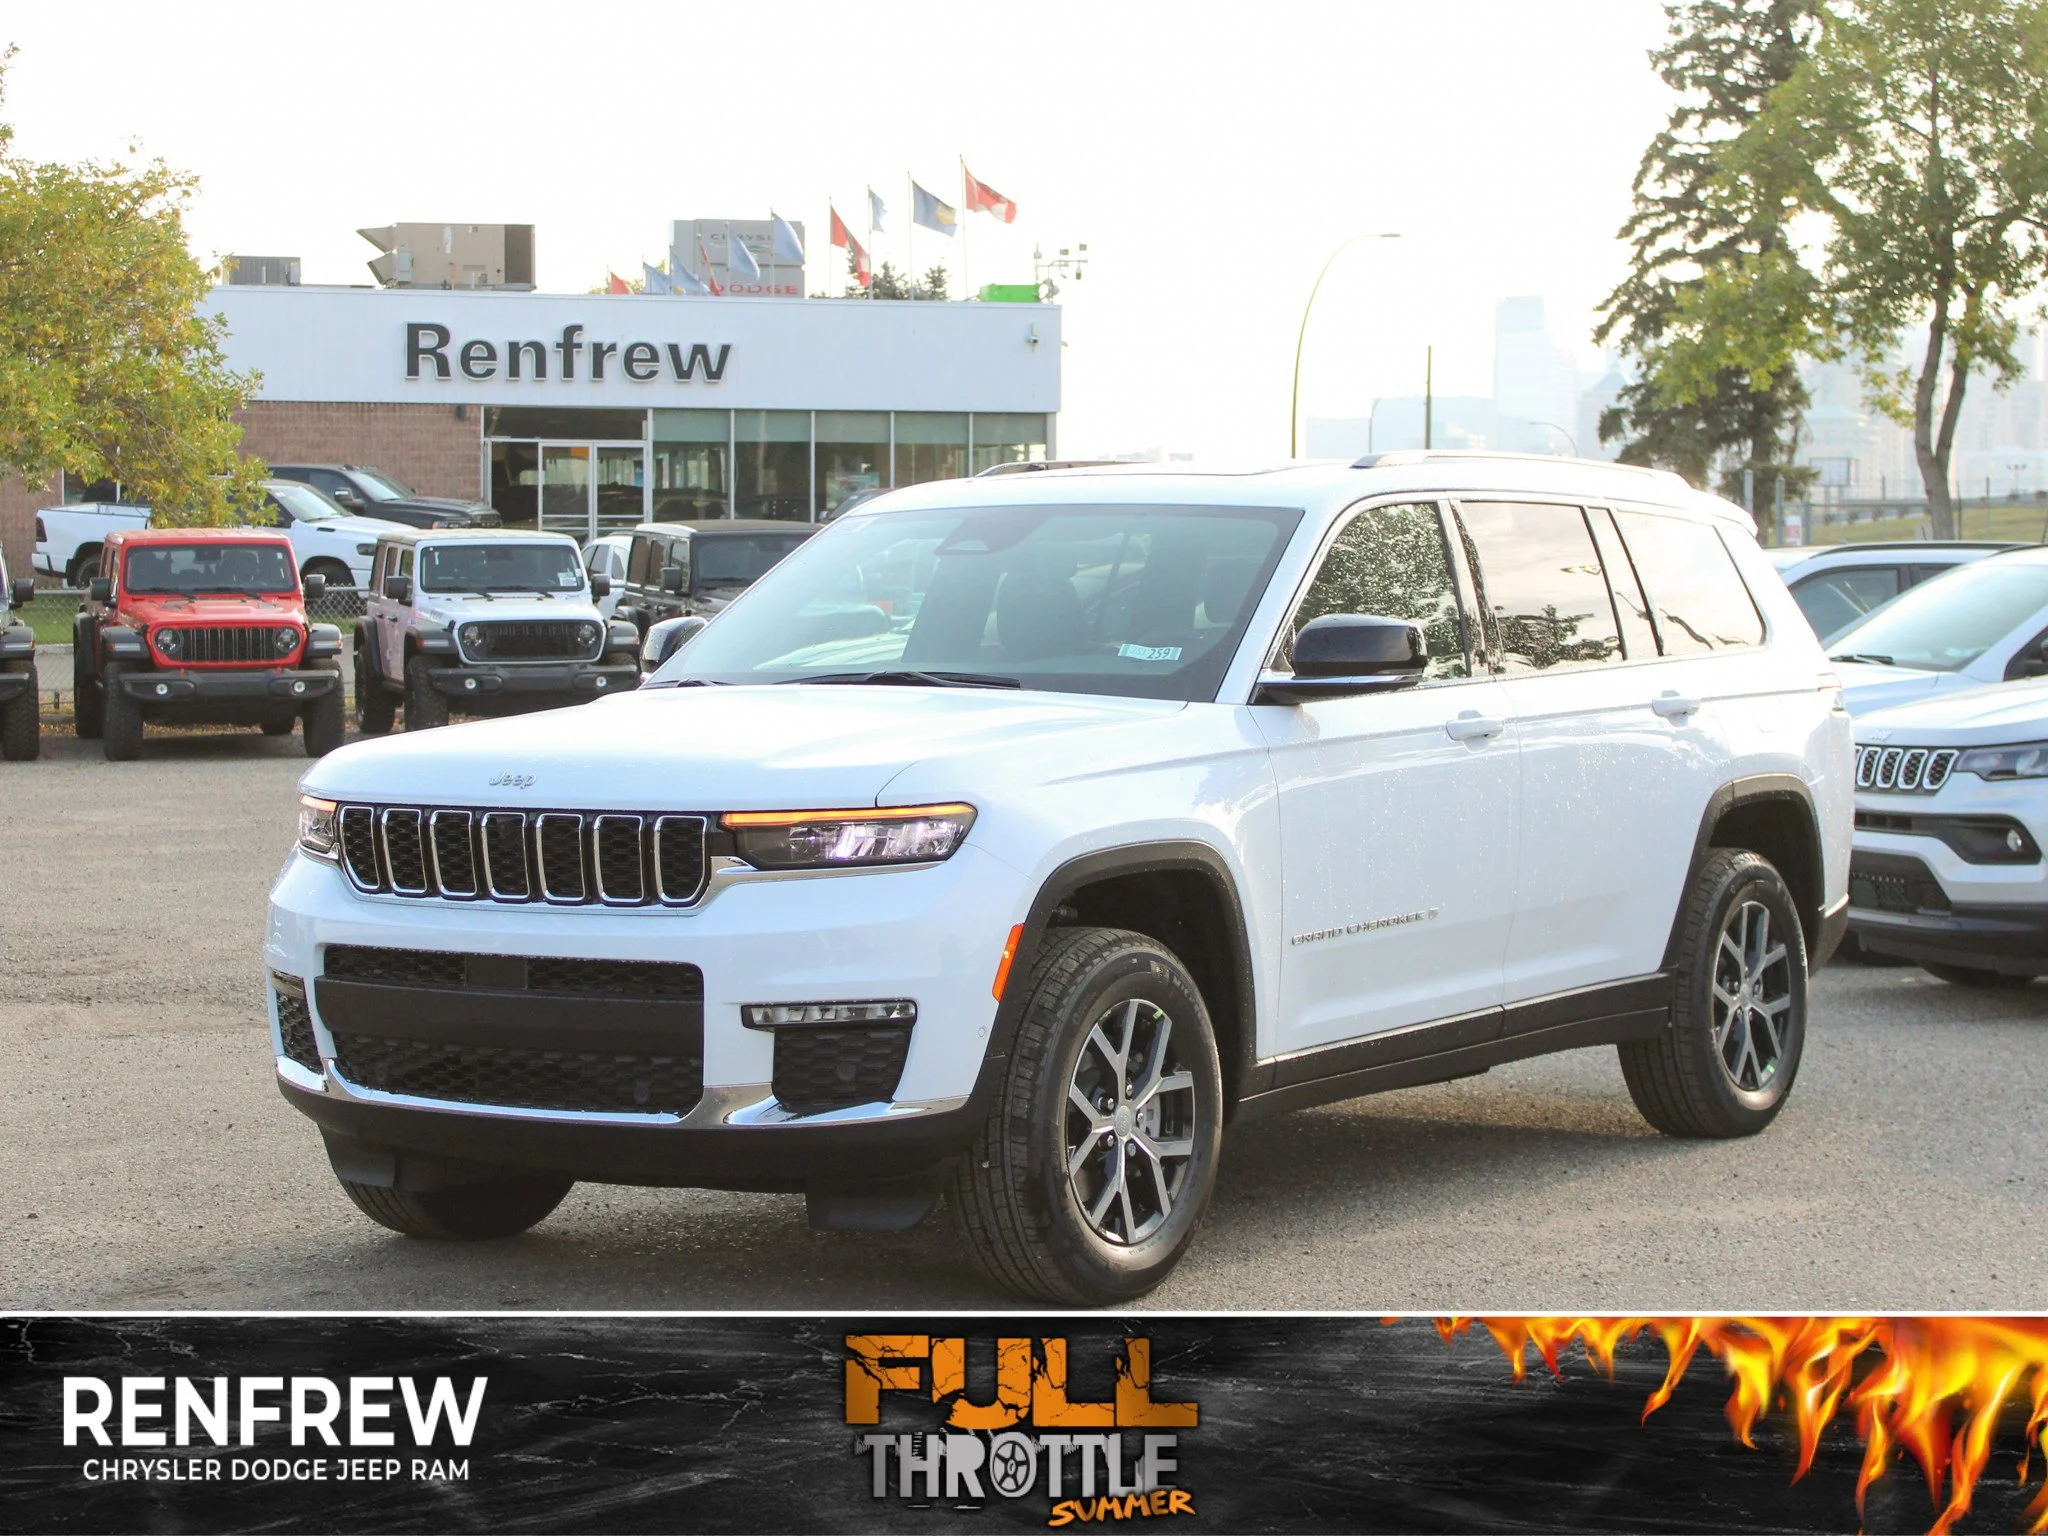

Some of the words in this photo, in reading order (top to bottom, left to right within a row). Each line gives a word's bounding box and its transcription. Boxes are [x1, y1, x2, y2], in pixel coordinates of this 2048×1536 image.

[405, 322, 732, 383] Renfrew
[489, 770, 537, 790] Jeep
[1291, 926, 1344, 946] GRAND
[1346, 911, 1426, 935] CHEROKEE
